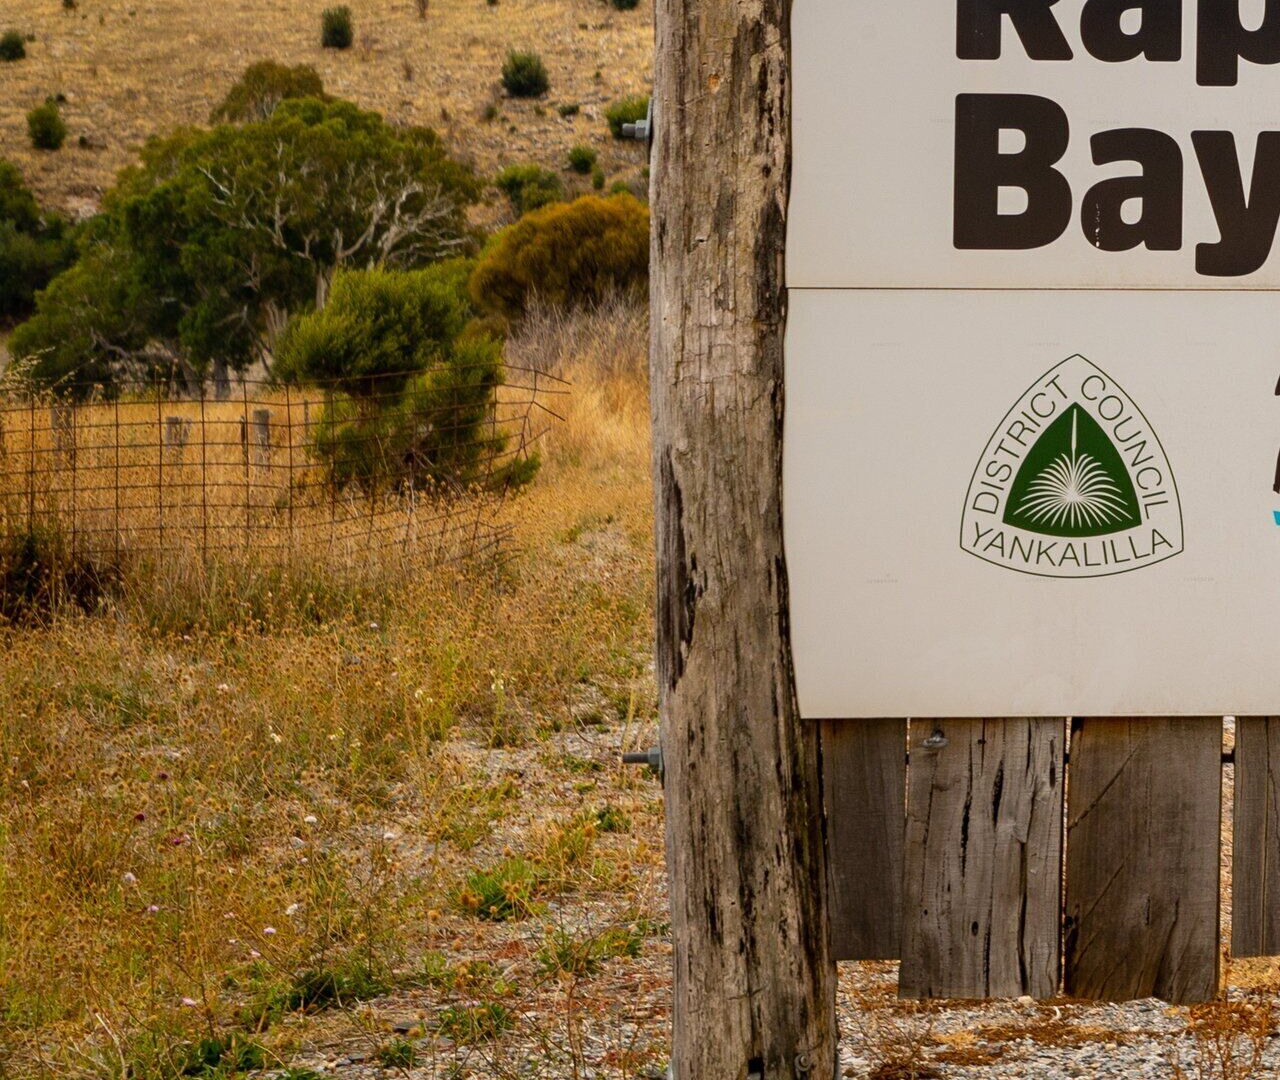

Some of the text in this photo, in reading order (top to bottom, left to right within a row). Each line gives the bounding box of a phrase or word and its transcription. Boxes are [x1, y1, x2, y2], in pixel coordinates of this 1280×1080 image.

[972, 374, 1169, 520] DISTRICT COUNCIL
[972, 522, 1173, 567] YANKALILLA
